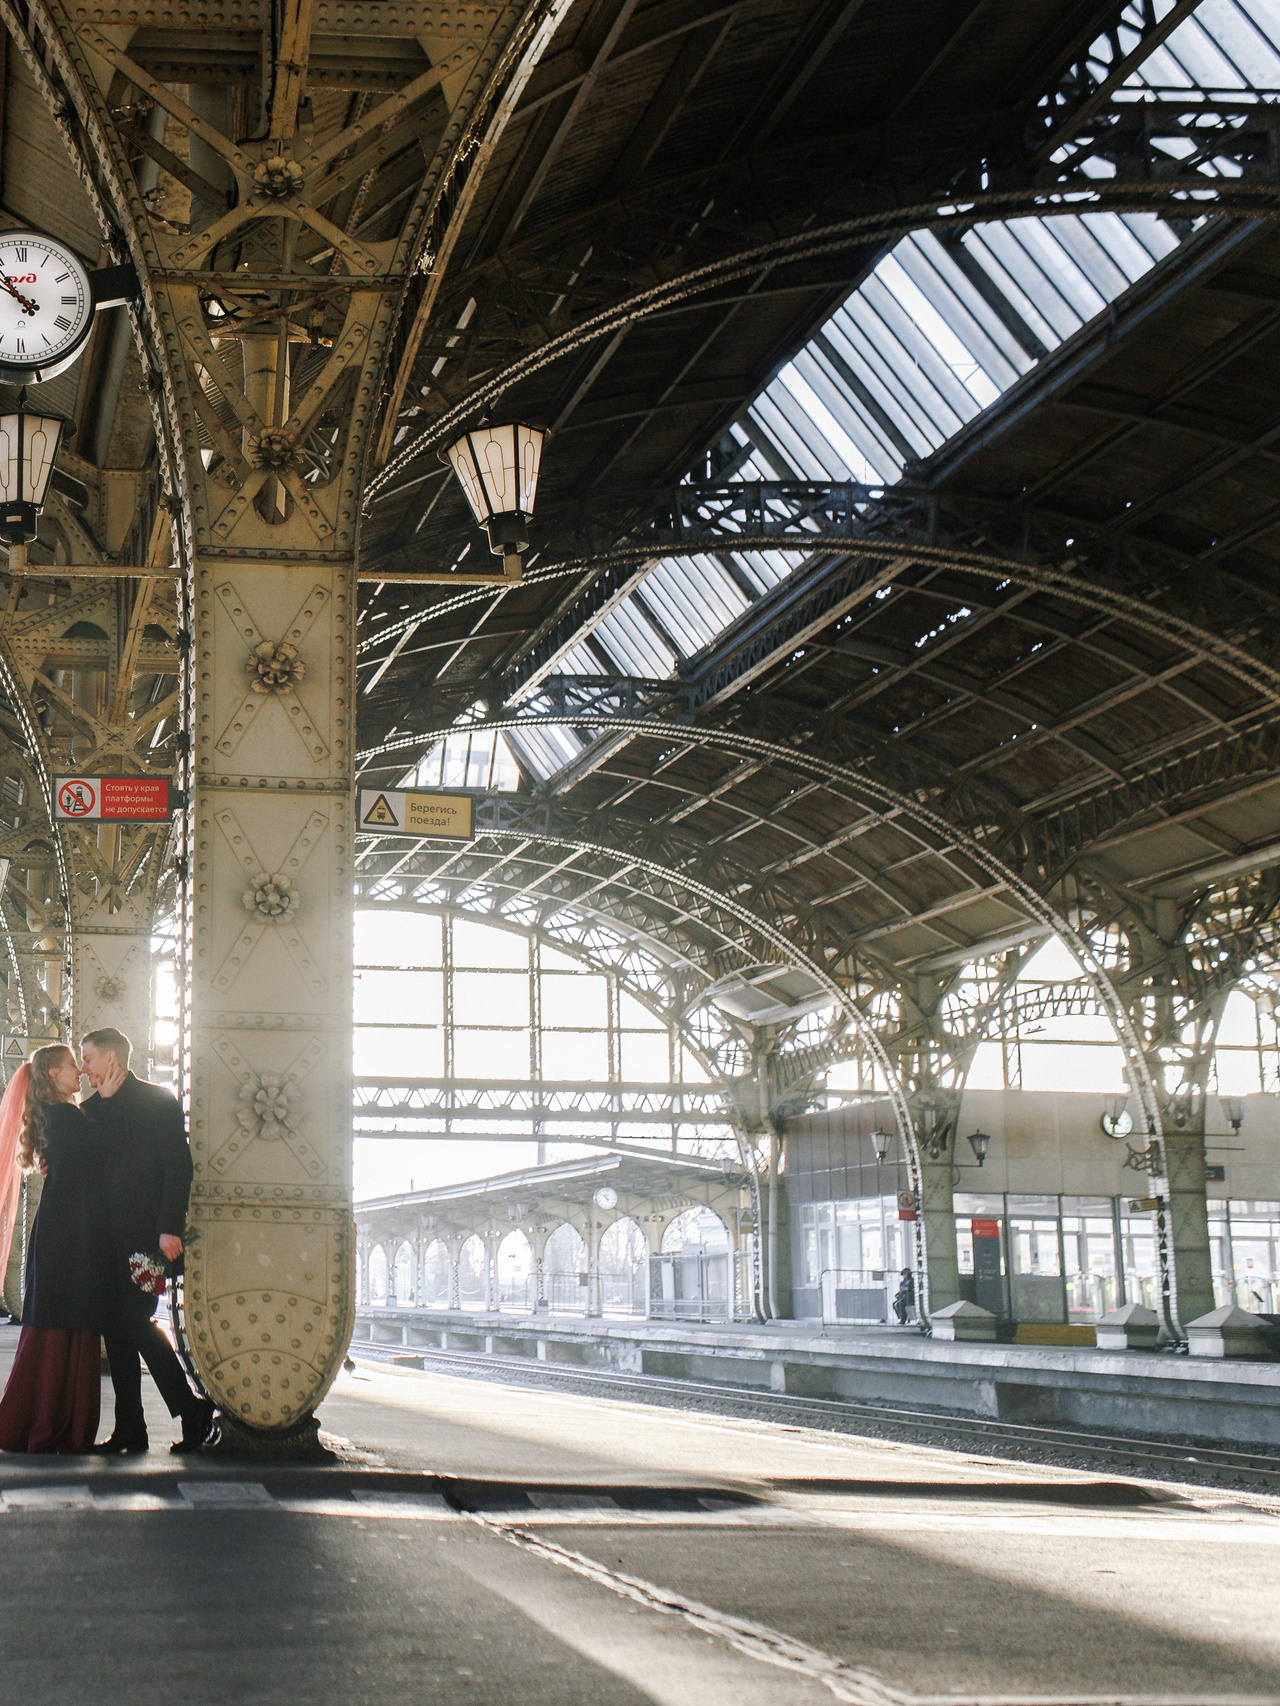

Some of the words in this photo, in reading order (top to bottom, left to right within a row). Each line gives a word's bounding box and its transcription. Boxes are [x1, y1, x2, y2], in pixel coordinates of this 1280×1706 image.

[15, 247, 28, 262] XII
[55, 272, 70, 283] II
[61, 296, 77, 304] III
[17, 338, 26, 353] VI
[105, 784, 133, 792] Стоять
[134, 785, 139, 794] у
[140, 785, 160, 793] края
[105, 795, 153, 803] платформы
[116, 806, 167, 815] допускается
[411, 803, 458, 815] Берегись
[410, 816, 450, 827] поезда!
